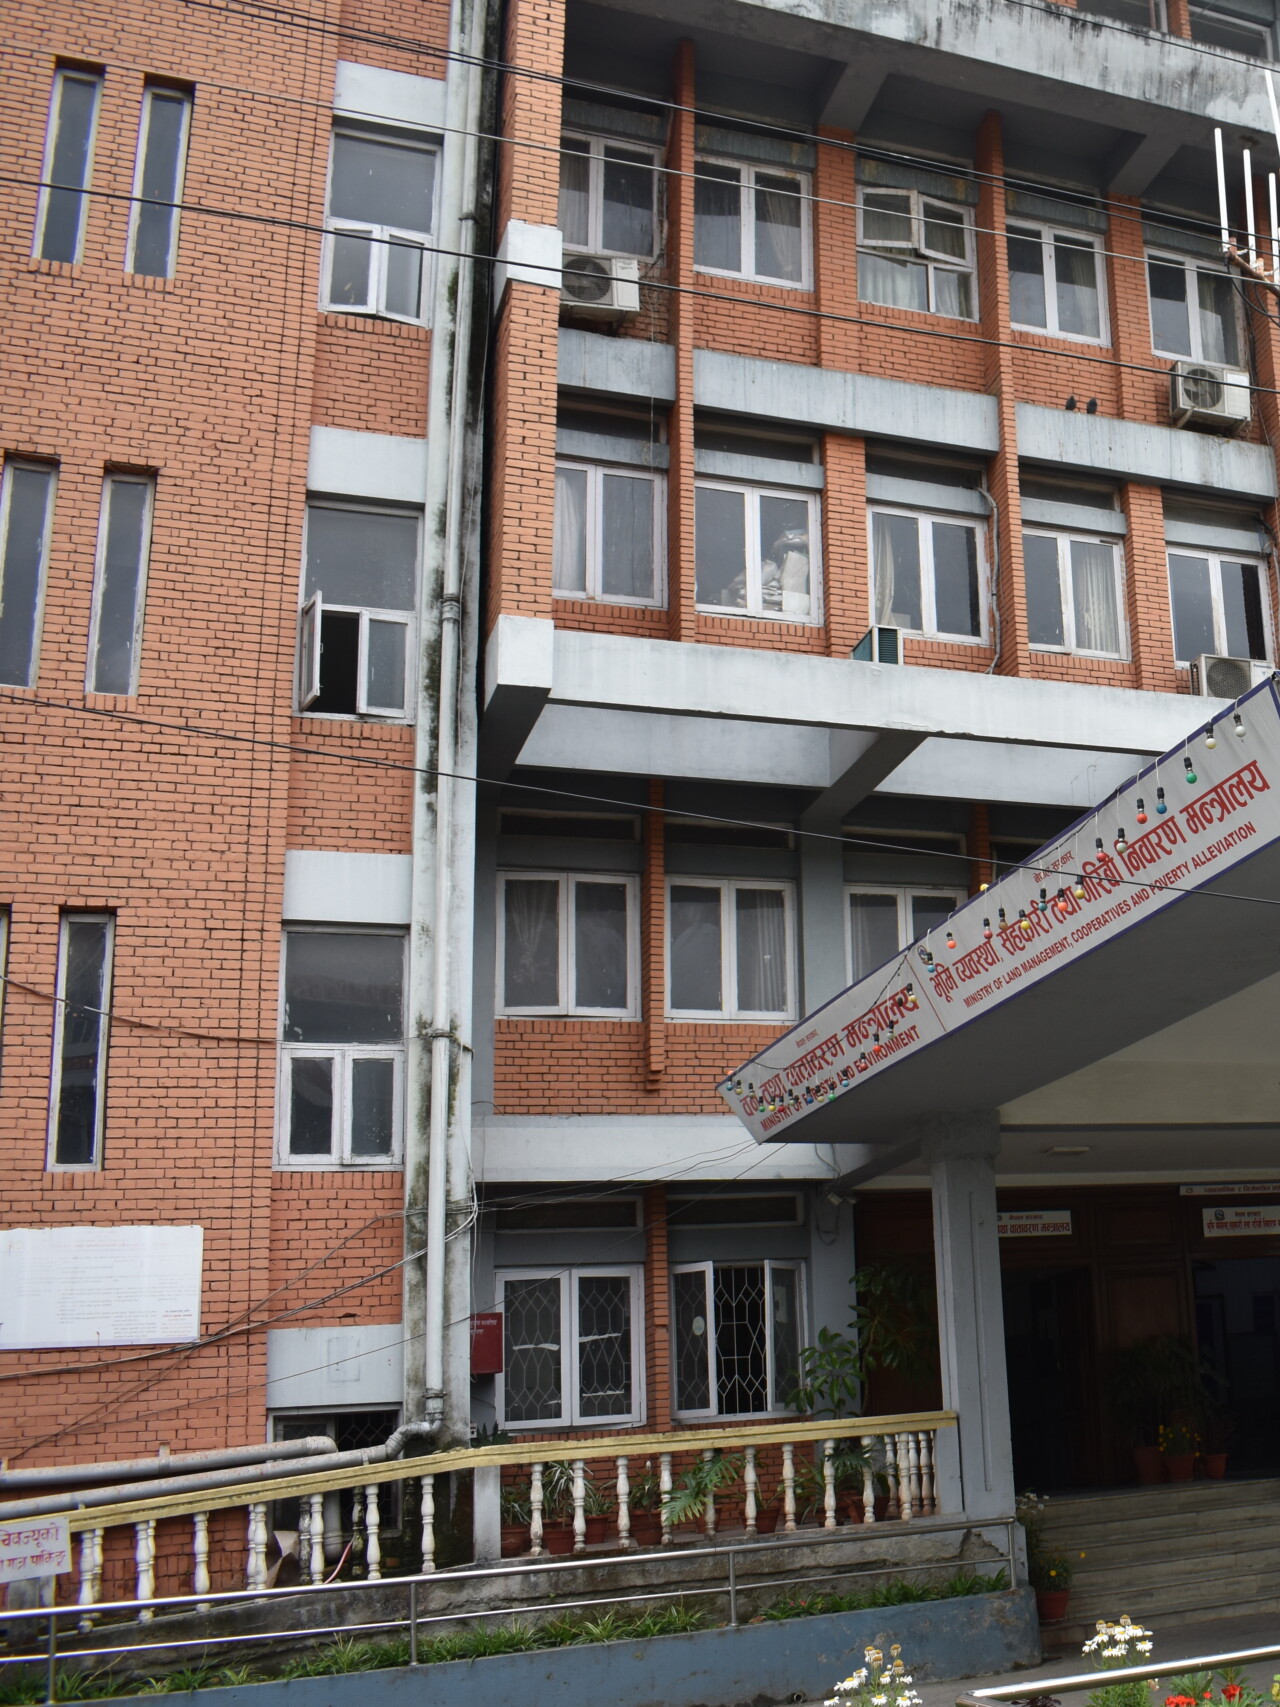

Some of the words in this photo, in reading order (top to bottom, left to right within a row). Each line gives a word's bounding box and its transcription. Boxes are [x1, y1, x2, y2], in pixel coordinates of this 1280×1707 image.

[929, 963, 959, 1003] भूमि
[996, 899, 1053, 956] सहकारी
[1046, 886, 1082, 924] तथा
[1114, 815, 1187, 877] निवारण
[1179, 759, 1271, 834] मन्त्रालय
[963, 982, 994, 1008] MINISTRY
[994, 977, 1004, 989] OF
[1002, 966, 1022, 984] LAND
[1020, 936, 1074, 974] MANAGEMENT,
[1071, 899, 1132, 943] COOPERATIVES
[1130, 888, 1150, 907] AND
[1150, 861, 1191, 895] POVERTY
[1191, 821, 1257, 870] ALLEVIATION
[837, 1065, 855, 1086] AD
[853, 1024, 920, 1074] EVIRONMENT
[1010, 1223, 1038, 1233] वातावरण
